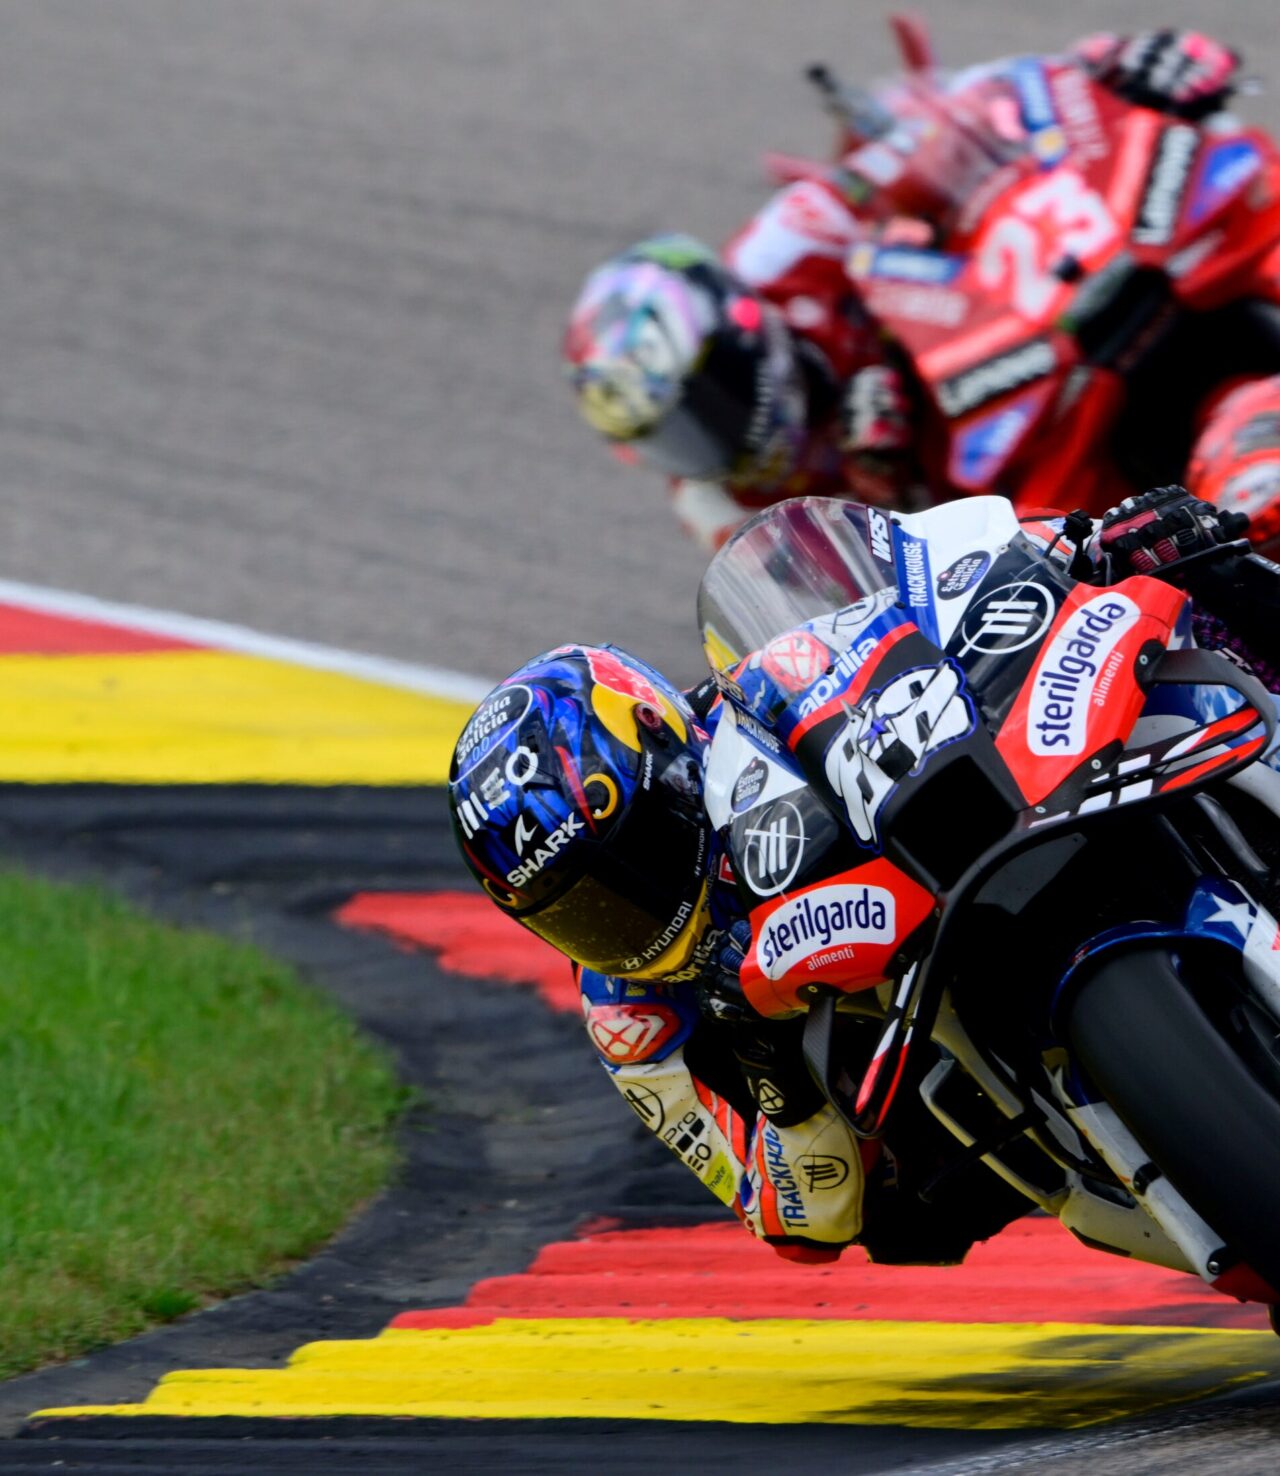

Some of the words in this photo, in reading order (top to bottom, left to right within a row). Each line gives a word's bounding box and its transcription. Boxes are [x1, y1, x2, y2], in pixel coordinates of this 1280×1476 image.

[976, 170, 1118, 322] 23
[902, 541, 929, 608] TRACKHOUSE
[941, 557, 972, 593] Estrella
[953, 558, 983, 591] Galicia
[799, 635, 880, 719] aprilia
[1041, 600, 1127, 748] sterilgarda
[1091, 649, 1125, 708] alimenti
[643, 750, 654, 792] SHARK
[507, 811, 586, 887] SHARK
[696, 827, 706, 863] HYUNDAI
[642, 901, 693, 960] HYUNDAI
[761, 887, 887, 960] sterilgarda
[662, 929, 725, 984] aprilia
[806, 945, 855, 972] alimenti
